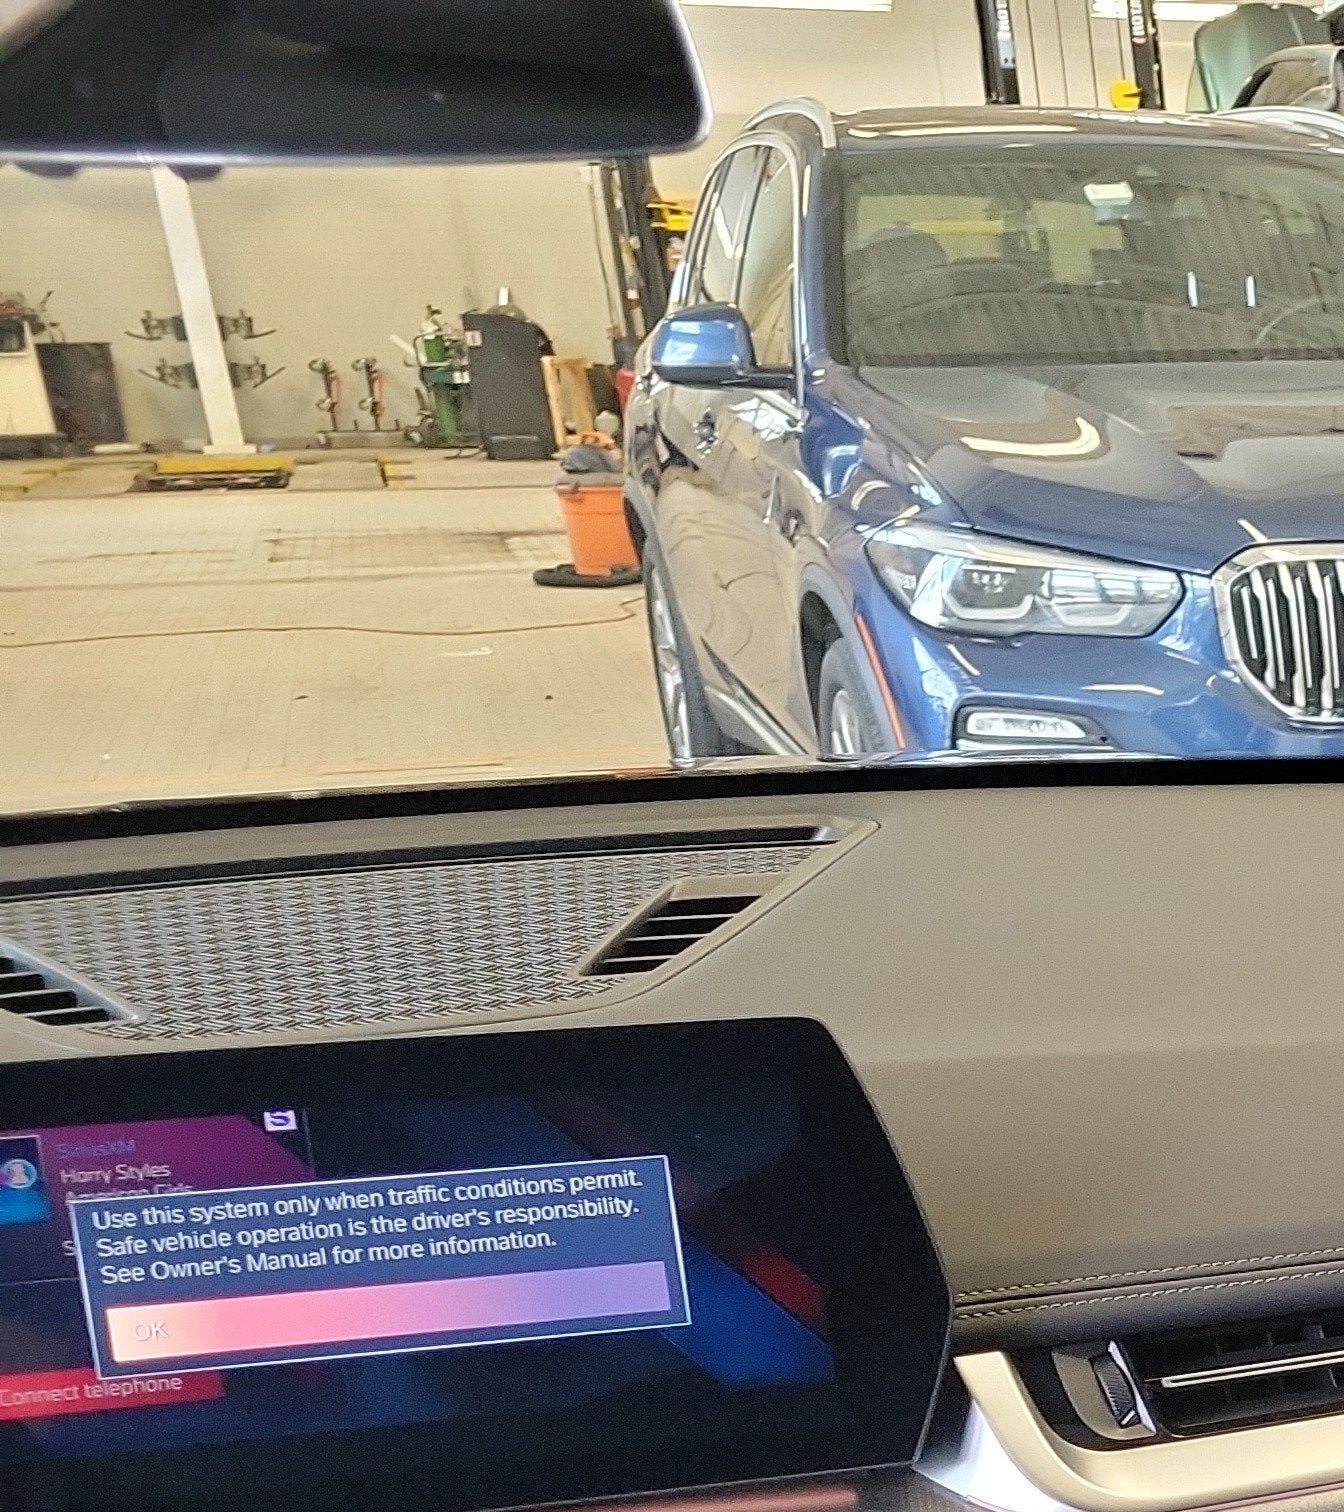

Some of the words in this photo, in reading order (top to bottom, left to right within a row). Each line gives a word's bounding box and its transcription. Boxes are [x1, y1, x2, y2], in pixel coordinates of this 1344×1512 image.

[115, 1163, 172, 1181] Styles
[92, 1210, 138, 1230] Use
[142, 1206, 185, 1226] this
[189, 1200, 269, 1225] system
[274, 1194, 320, 1217] only
[324, 1190, 384, 1211] when
[388, 1184, 450, 1206] traffic
[454, 1177, 566, 1201] conditions
[569, 1169, 643, 1197] permit.
[96, 1236, 148, 1258] Safe
[152, 1229, 233, 1253] vehicle
[236, 1221, 342, 1249] operation
[347, 1217, 367, 1237] is
[370, 1215, 408, 1234] the
[412, 1208, 491, 1232] driver's
[495, 1197, 640, 1226] responsibility.
[102, 1265, 146, 1285] See
[150, 1255, 242, 1281] Owner's
[246, 1249, 327, 1273] Manual
[331, 1246, 363, 1266] for
[368, 1242, 424, 1263] more
[428, 1231, 557, 1257] information.
[132, 1320, 168, 1342] OK
[83, 1375, 183, 1399] telephone
